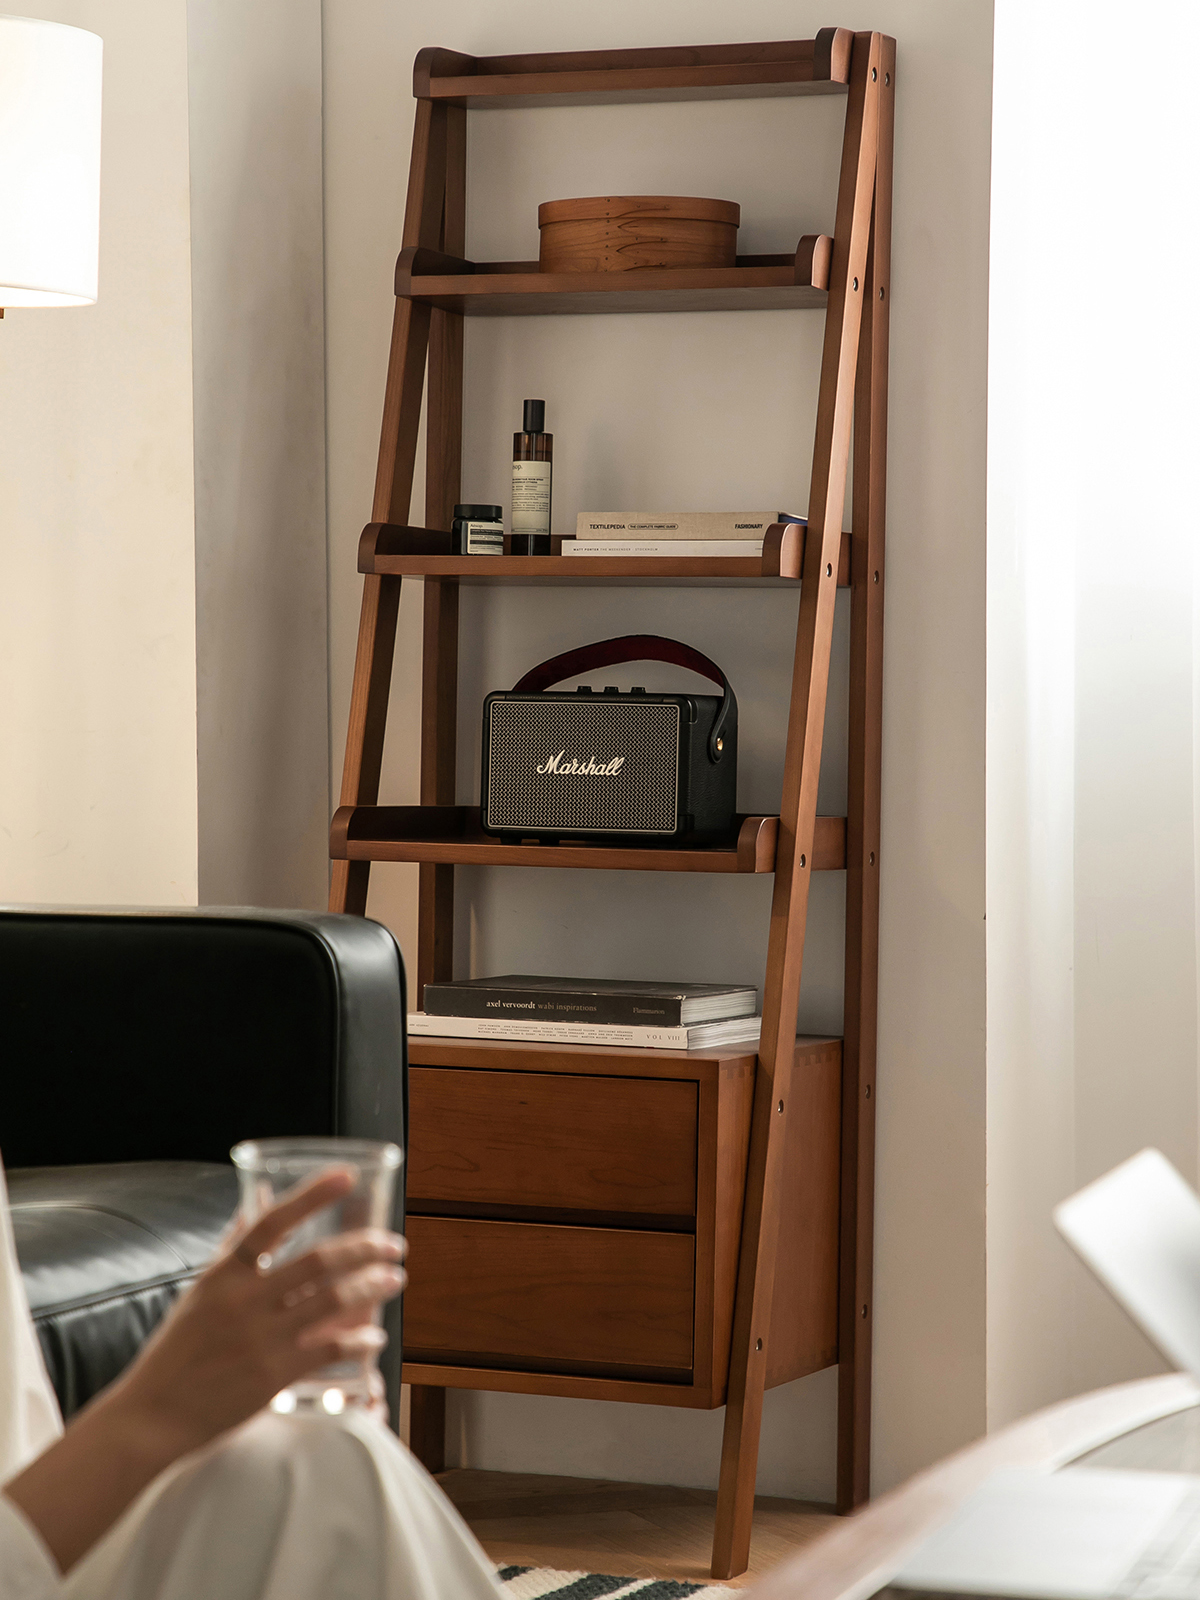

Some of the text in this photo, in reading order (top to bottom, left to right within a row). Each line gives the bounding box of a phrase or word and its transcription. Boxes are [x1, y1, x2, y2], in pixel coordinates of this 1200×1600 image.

[536, 750, 625, 776] Marshall
[502, 1001, 536, 1009] vervoordt
[537, 1002, 555, 1010] wabi
[556, 1002, 597, 1012] inspirations
[632, 1007, 665, 1015] Flammarion
